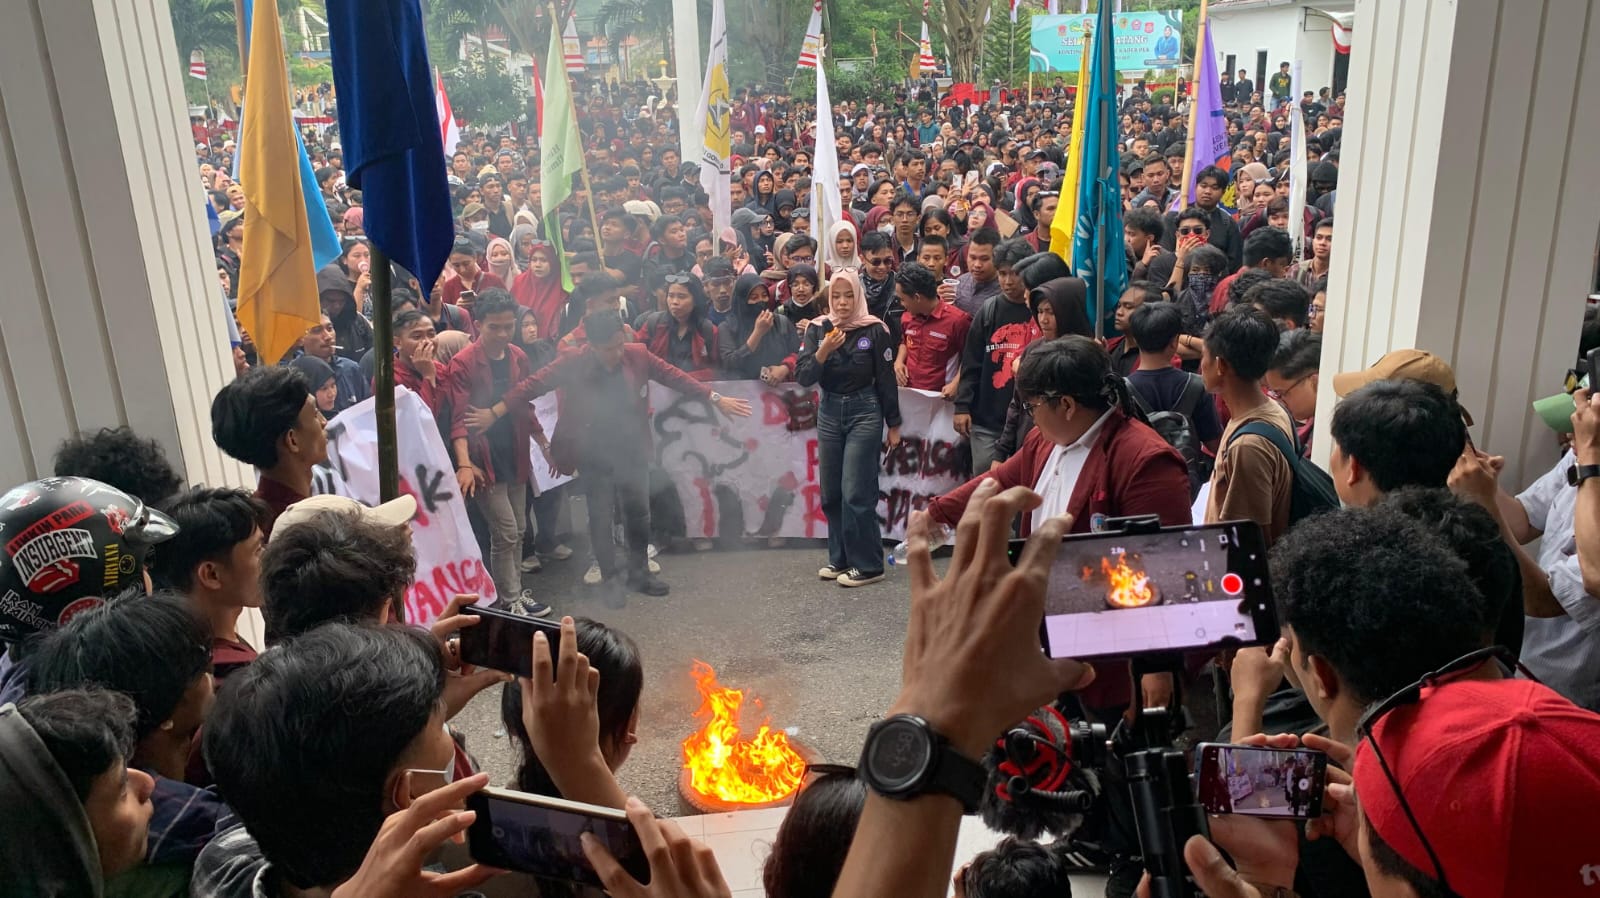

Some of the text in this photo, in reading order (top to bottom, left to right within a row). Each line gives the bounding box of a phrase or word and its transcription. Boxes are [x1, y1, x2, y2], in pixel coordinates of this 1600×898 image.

[52, 504, 87, 525] PARK
[15, 529, 96, 582] INSURGENT
[104, 543, 119, 586] NIRVANA
[1, 589, 43, 617] IRON
